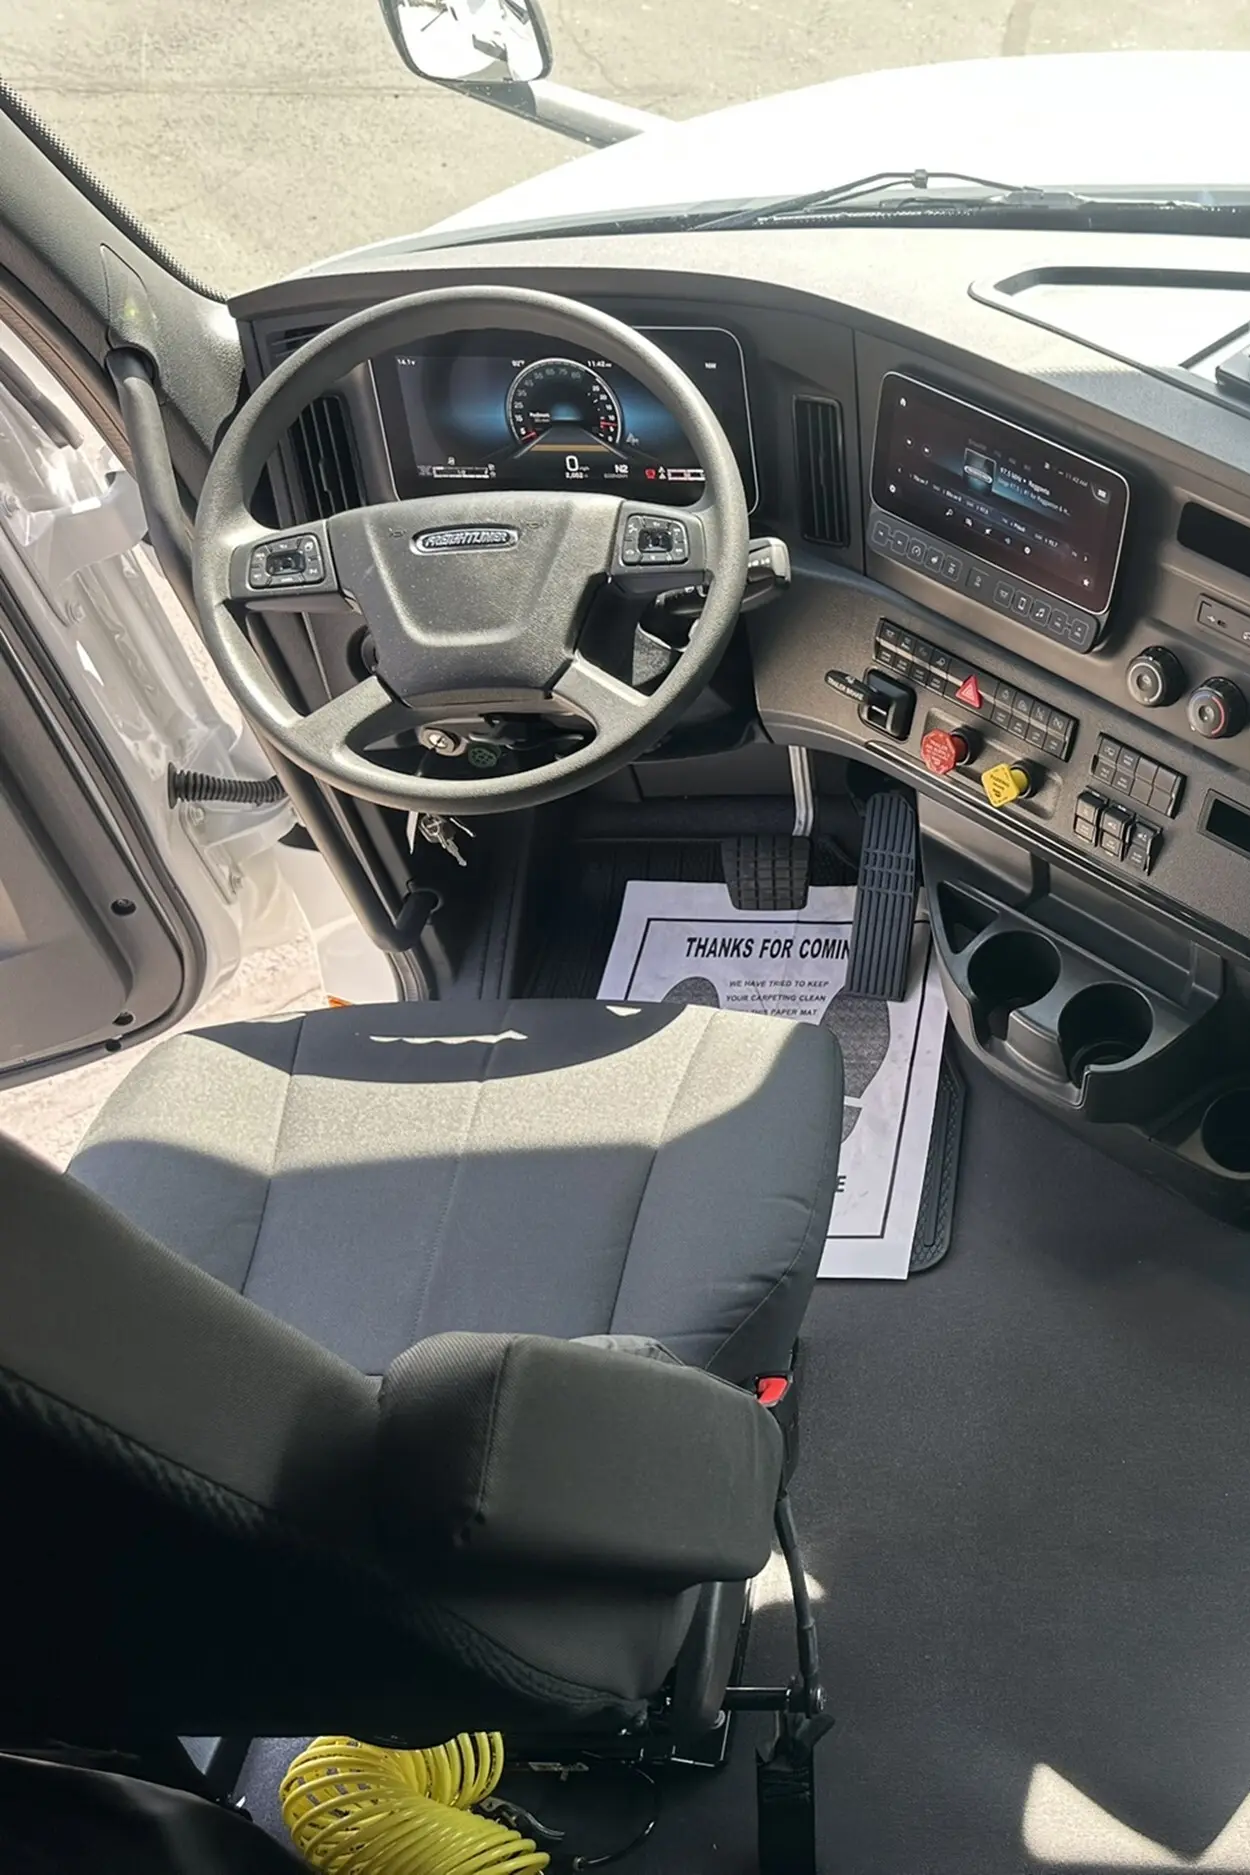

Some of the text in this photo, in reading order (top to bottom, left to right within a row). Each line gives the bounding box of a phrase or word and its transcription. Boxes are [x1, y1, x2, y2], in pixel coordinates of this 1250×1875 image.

[565, 455, 579, 471] 0
[423, 530, 508, 547] FREIGHTLINER
[685, 937, 851, 960] THANKS FOR COMIN
[729, 980, 830, 988] WE HAVE TRIED TO KEEP
[726, 994, 827, 1002] YOUR CARPETING CLEAN
[770, 1009, 798, 1017] PAPER
[800, 1009, 818, 1017] MAT
